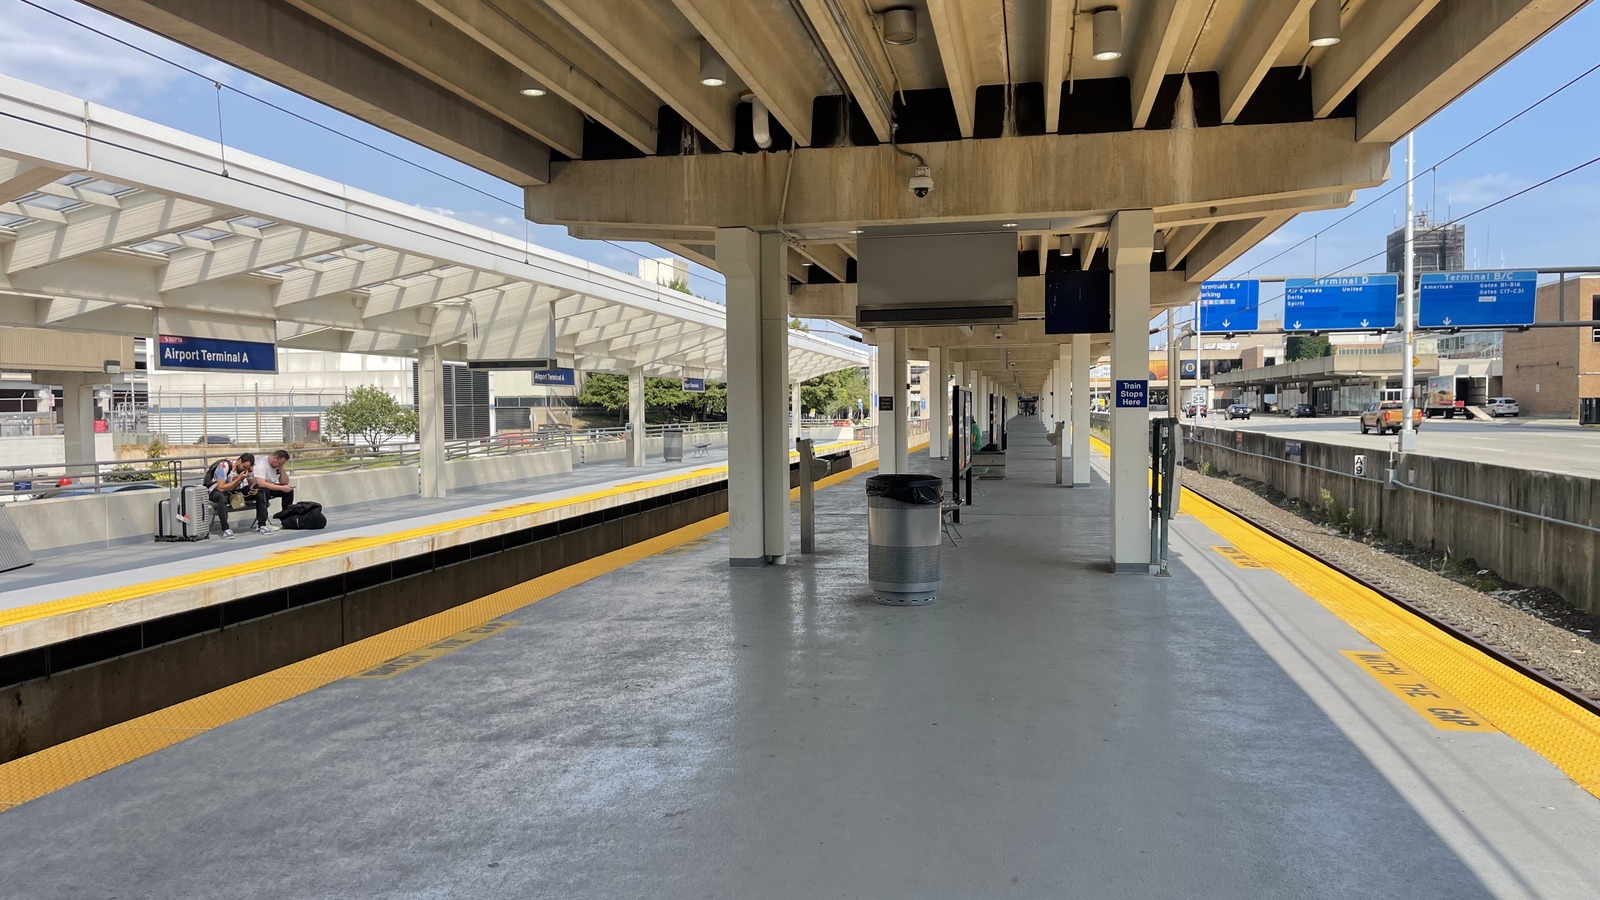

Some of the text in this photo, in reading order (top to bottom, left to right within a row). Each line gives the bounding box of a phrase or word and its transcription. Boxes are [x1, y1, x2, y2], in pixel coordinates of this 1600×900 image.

[1314, 276, 1369, 285] Terminal D
[1444, 272, 1514, 281] Terminal B/C
[164, 347, 249, 362] Airport Terminal A
[1120, 390, 1144, 398] Stops
[1356, 456, 1363, 465] A
[1356, 466, 1362, 474] 9
[1394, 684, 1441, 698] THE
[1426, 707, 1480, 727] GAP
